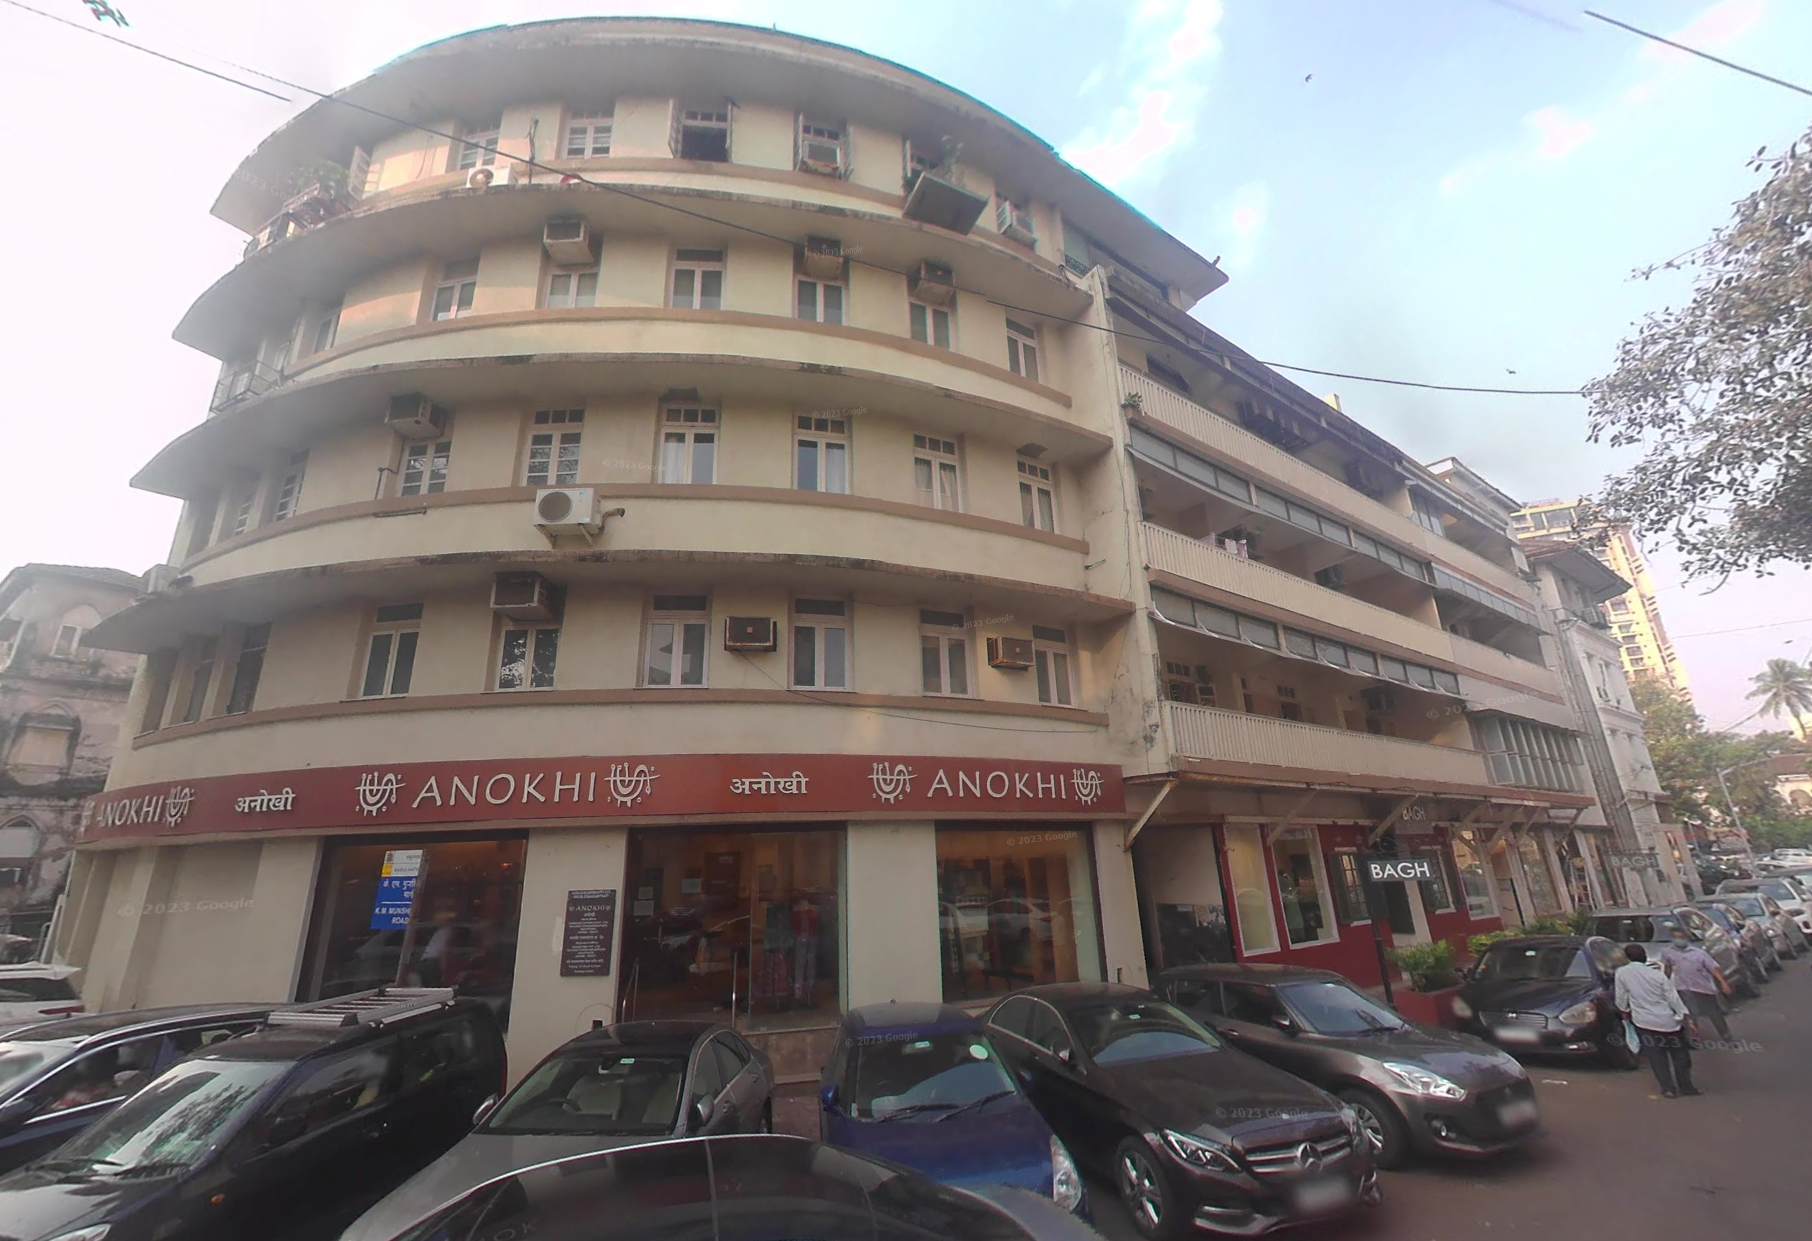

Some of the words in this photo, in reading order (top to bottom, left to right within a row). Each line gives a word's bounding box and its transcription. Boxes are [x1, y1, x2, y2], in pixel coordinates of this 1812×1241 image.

[411, 770, 596, 808] ANOKHI
[730, 771, 810, 795] अनोखी
[927, 768, 1067, 800] ANOKHI
[97, 794, 164, 829] ANOKHI
[234, 786, 297, 813] अनोखी
[1370, 862, 1430, 880] BAGH
